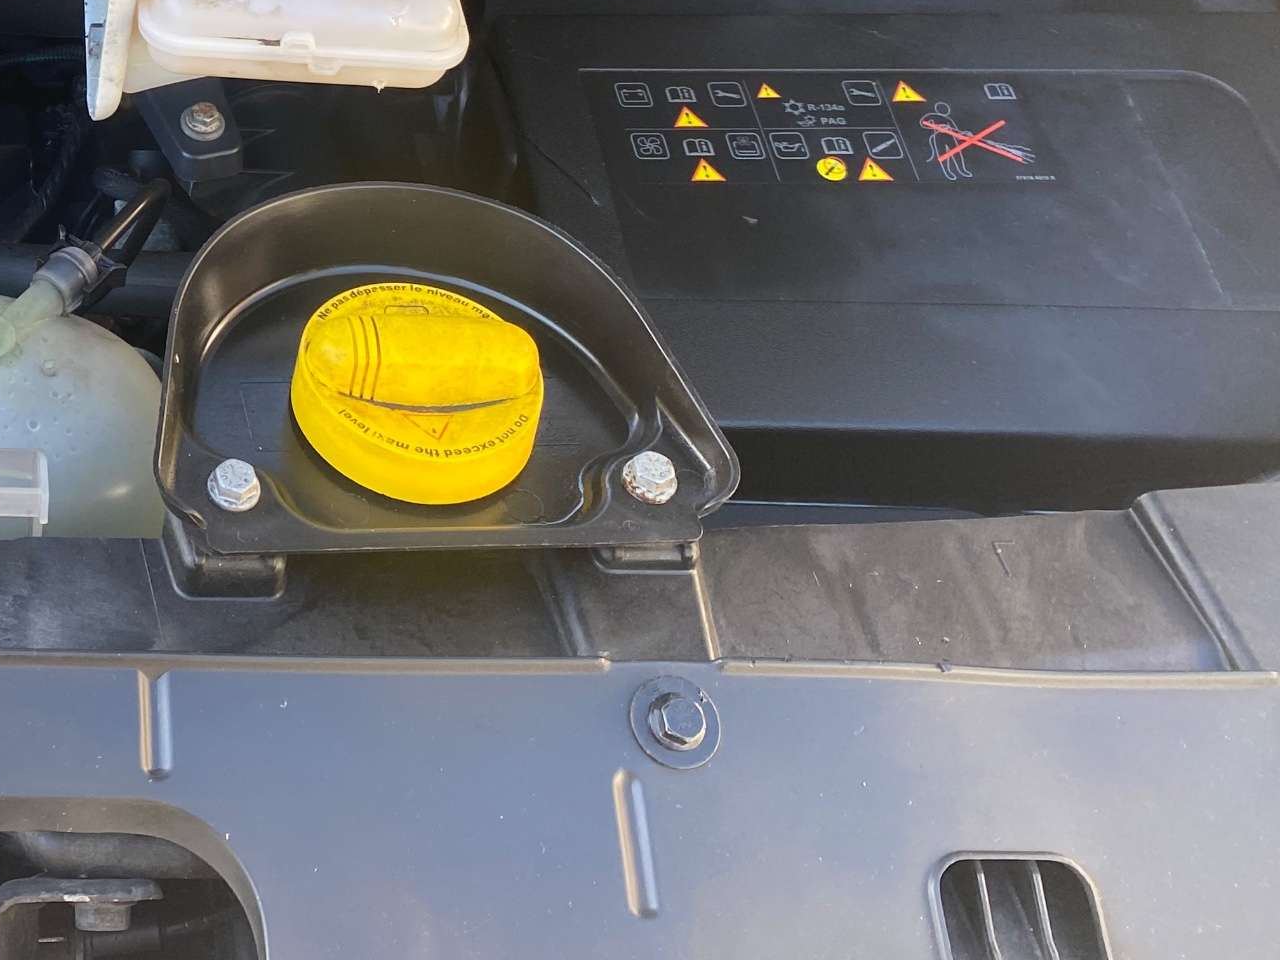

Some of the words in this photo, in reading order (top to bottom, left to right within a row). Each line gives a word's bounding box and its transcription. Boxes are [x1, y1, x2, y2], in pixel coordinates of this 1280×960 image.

[820, 117, 848, 126] PAG
[317, 308, 333, 321] Ne
[331, 295, 350, 311] pas
[410, 284, 423, 293] le
[426, 288, 470, 307] niveau
[337, 408, 371, 435] level
[514, 413, 530, 428] Do
[495, 427, 517, 444] not
[414, 446, 441, 458] the
[443, 439, 497, 458] exceed
